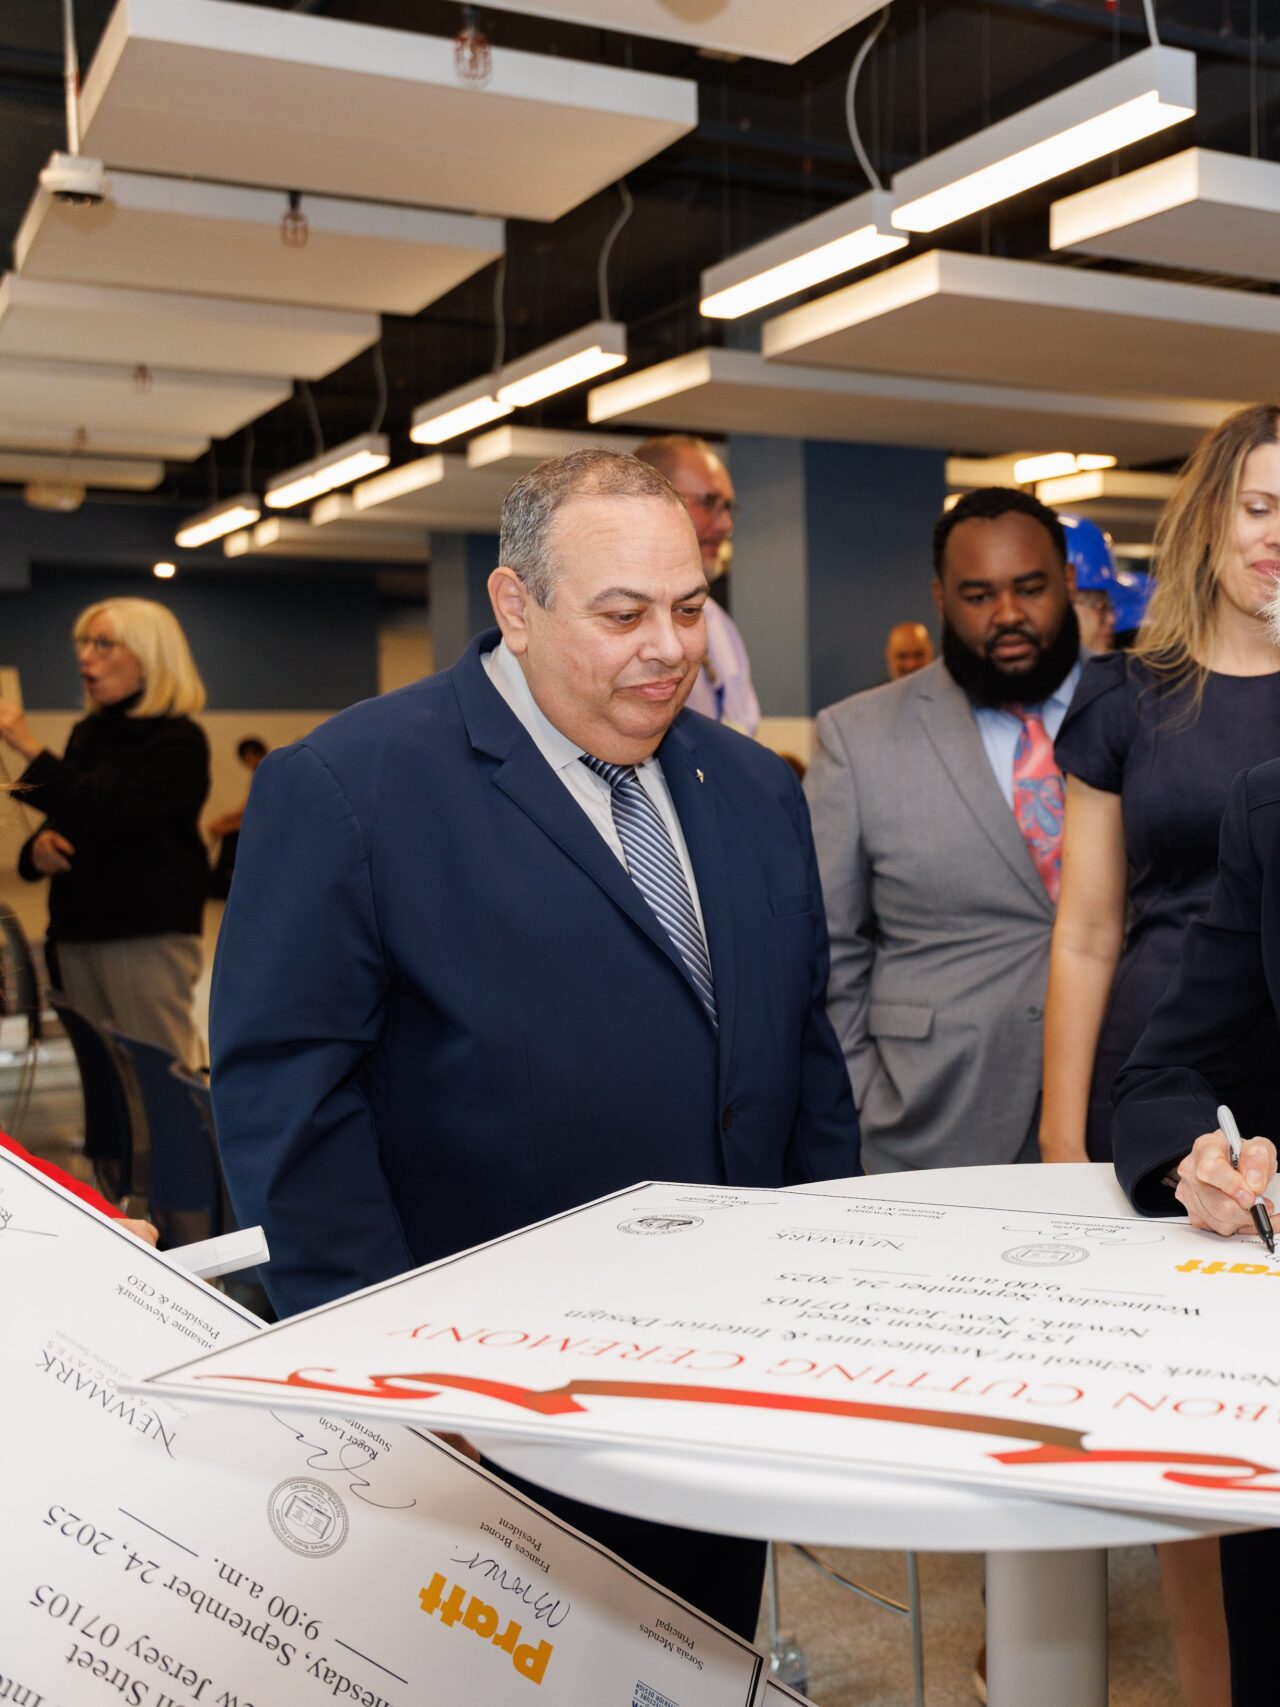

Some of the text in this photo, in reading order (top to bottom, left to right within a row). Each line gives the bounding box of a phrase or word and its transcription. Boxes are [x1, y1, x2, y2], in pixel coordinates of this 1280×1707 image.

[768, 1232, 905, 1251] NEWMARK
[773, 1272, 845, 1284] 2025
[893, 1280, 1033, 1303] September
[1001, 1278, 1062, 1292] 9:00
[114, 1283, 169, 1325] Newmark
[126, 1274, 221, 1341] President & CEO
[564, 1309, 660, 1328] Design
[760, 1296, 851, 1311] 07105
[856, 1301, 948, 1318] Jersey
[951, 1311, 1019, 1327] New
[1046, 1295, 1201, 1317] Wednesday,
[663, 1318, 771, 1340] Interior
[778, 1330, 808, 1343] &
[793, 1309, 1075, 1345] 155 Jefferson Street
[816, 1331, 994, 1360] Architecture
[386, 1323, 745, 1371] CEREMONY
[996, 1352, 1036, 1363] of
[1043, 1356, 1149, 1374] School
[46, 1339, 148, 1409] ASOCIATES
[764, 1359, 1084, 1405] CUTTING
[33, 1349, 177, 1461] NEWMARK
[318, 1416, 379, 1461] Roger León
[41, 1504, 114, 1556] 2025
[478, 1521, 551, 1574] Frances Bronet
[498, 1517, 543, 1552] President
[120, 1541, 160, 1585] 24,
[28, 1583, 121, 1649] 07105
[162, 1572, 297, 1667] September
[213, 1558, 323, 1642] 9:00 a.m.
[417, 1571, 554, 1686] Pratt
[638, 1623, 704, 1671] Soraia Mendes
[655, 1617, 695, 1650] Principal
[64, 1643, 150, 1707] Street
[124, 1632, 213, 1701] Jersey
